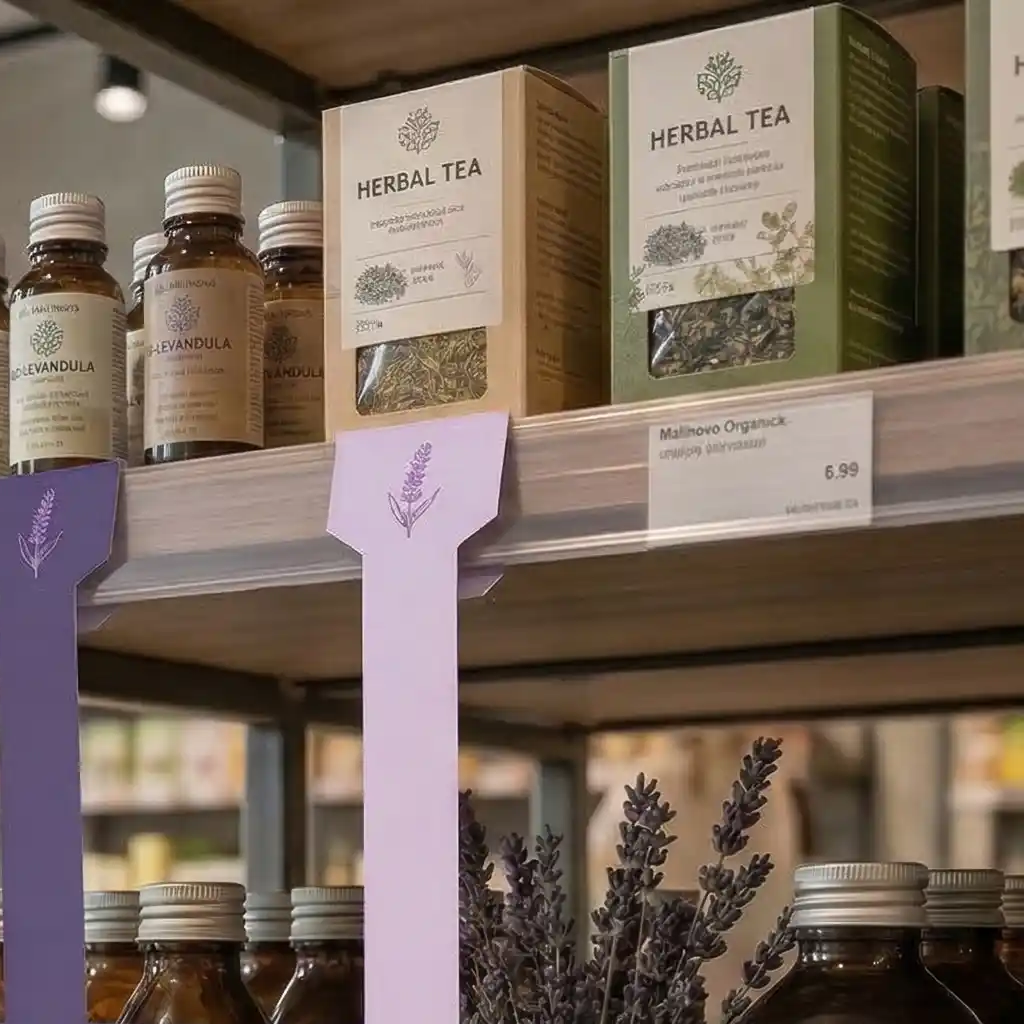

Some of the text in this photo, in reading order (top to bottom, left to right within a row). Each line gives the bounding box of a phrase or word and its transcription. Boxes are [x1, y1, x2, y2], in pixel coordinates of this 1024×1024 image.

[650, 104, 791, 151] HERBAL TEA
[357, 157, 483, 200] HERBAL TEA
